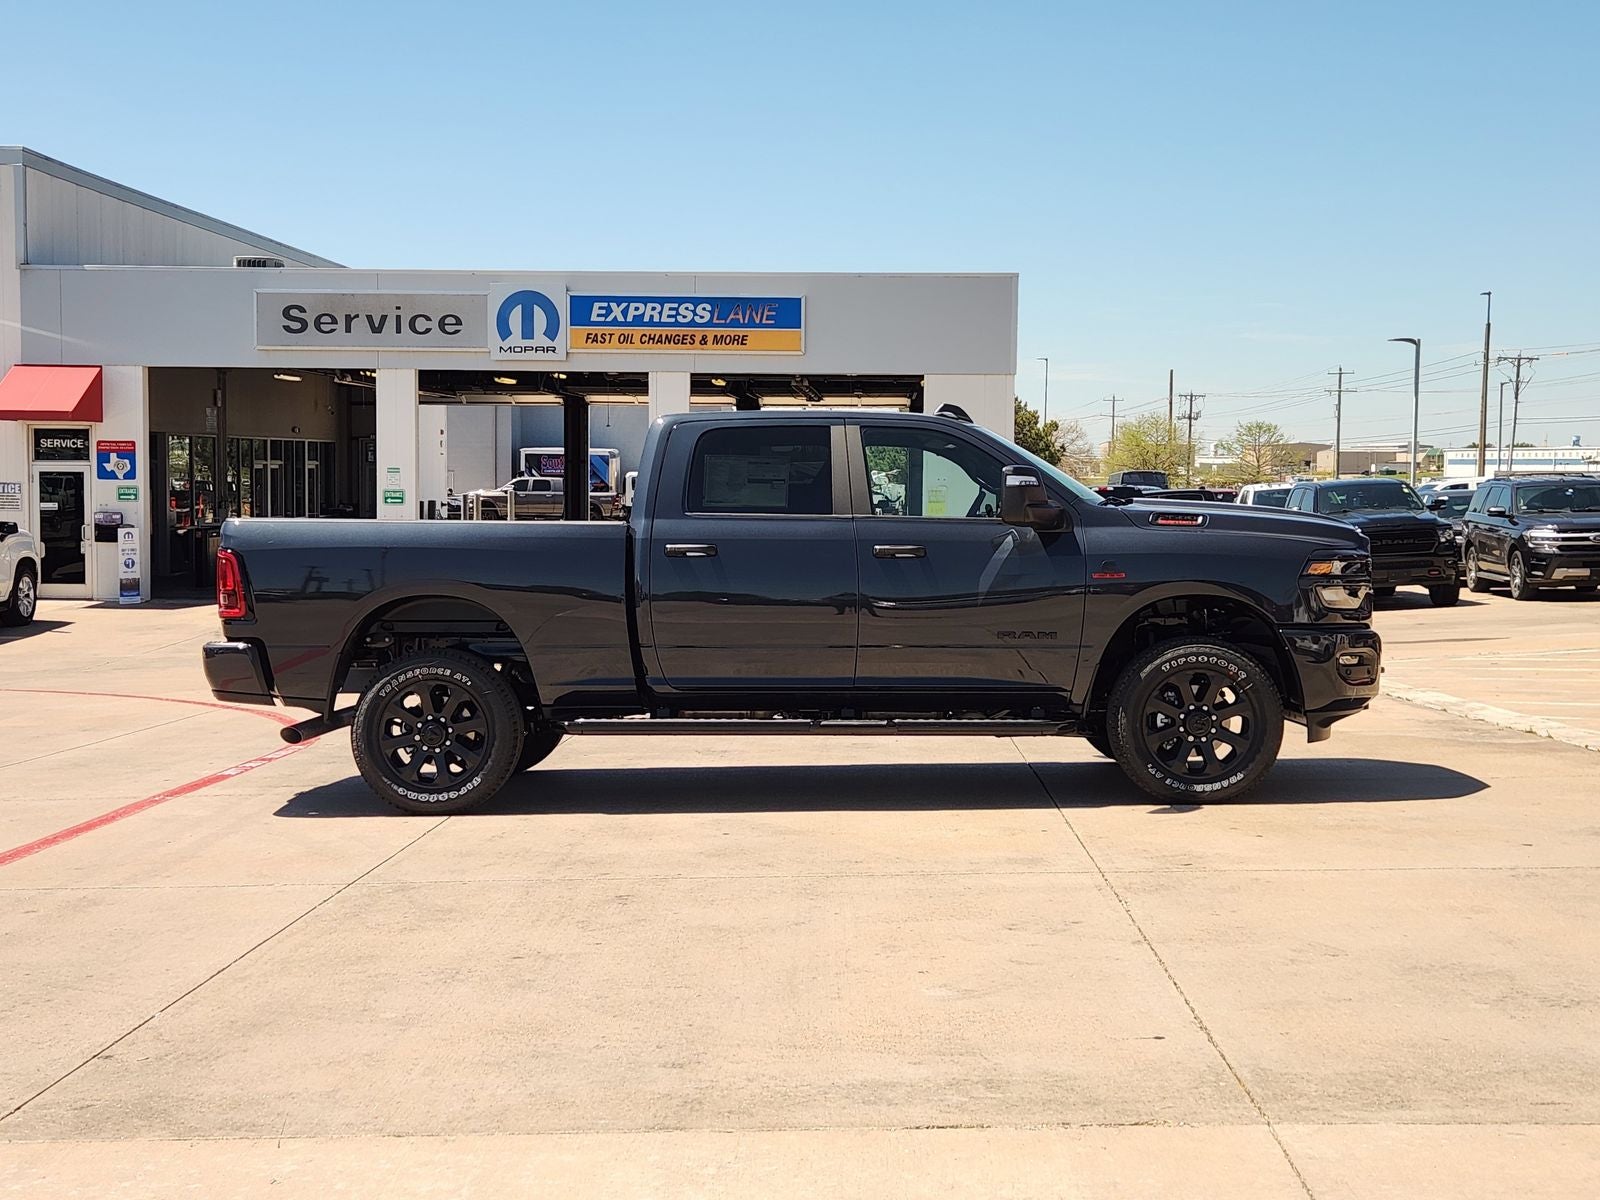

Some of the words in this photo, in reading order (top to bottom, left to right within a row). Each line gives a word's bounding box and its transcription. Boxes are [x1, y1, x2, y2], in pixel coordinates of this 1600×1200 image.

[281, 304, 463, 335] Service
[585, 333, 615, 344] FAST
[617, 333, 636, 345] OIL
[639, 333, 696, 346] CHANGES
[699, 334, 708, 346] &
[712, 334, 749, 346] MORE
[499, 345, 557, 354] MOPAR
[40, 438, 84, 448] SERVICE
[997, 630, 1058, 640] RAM
